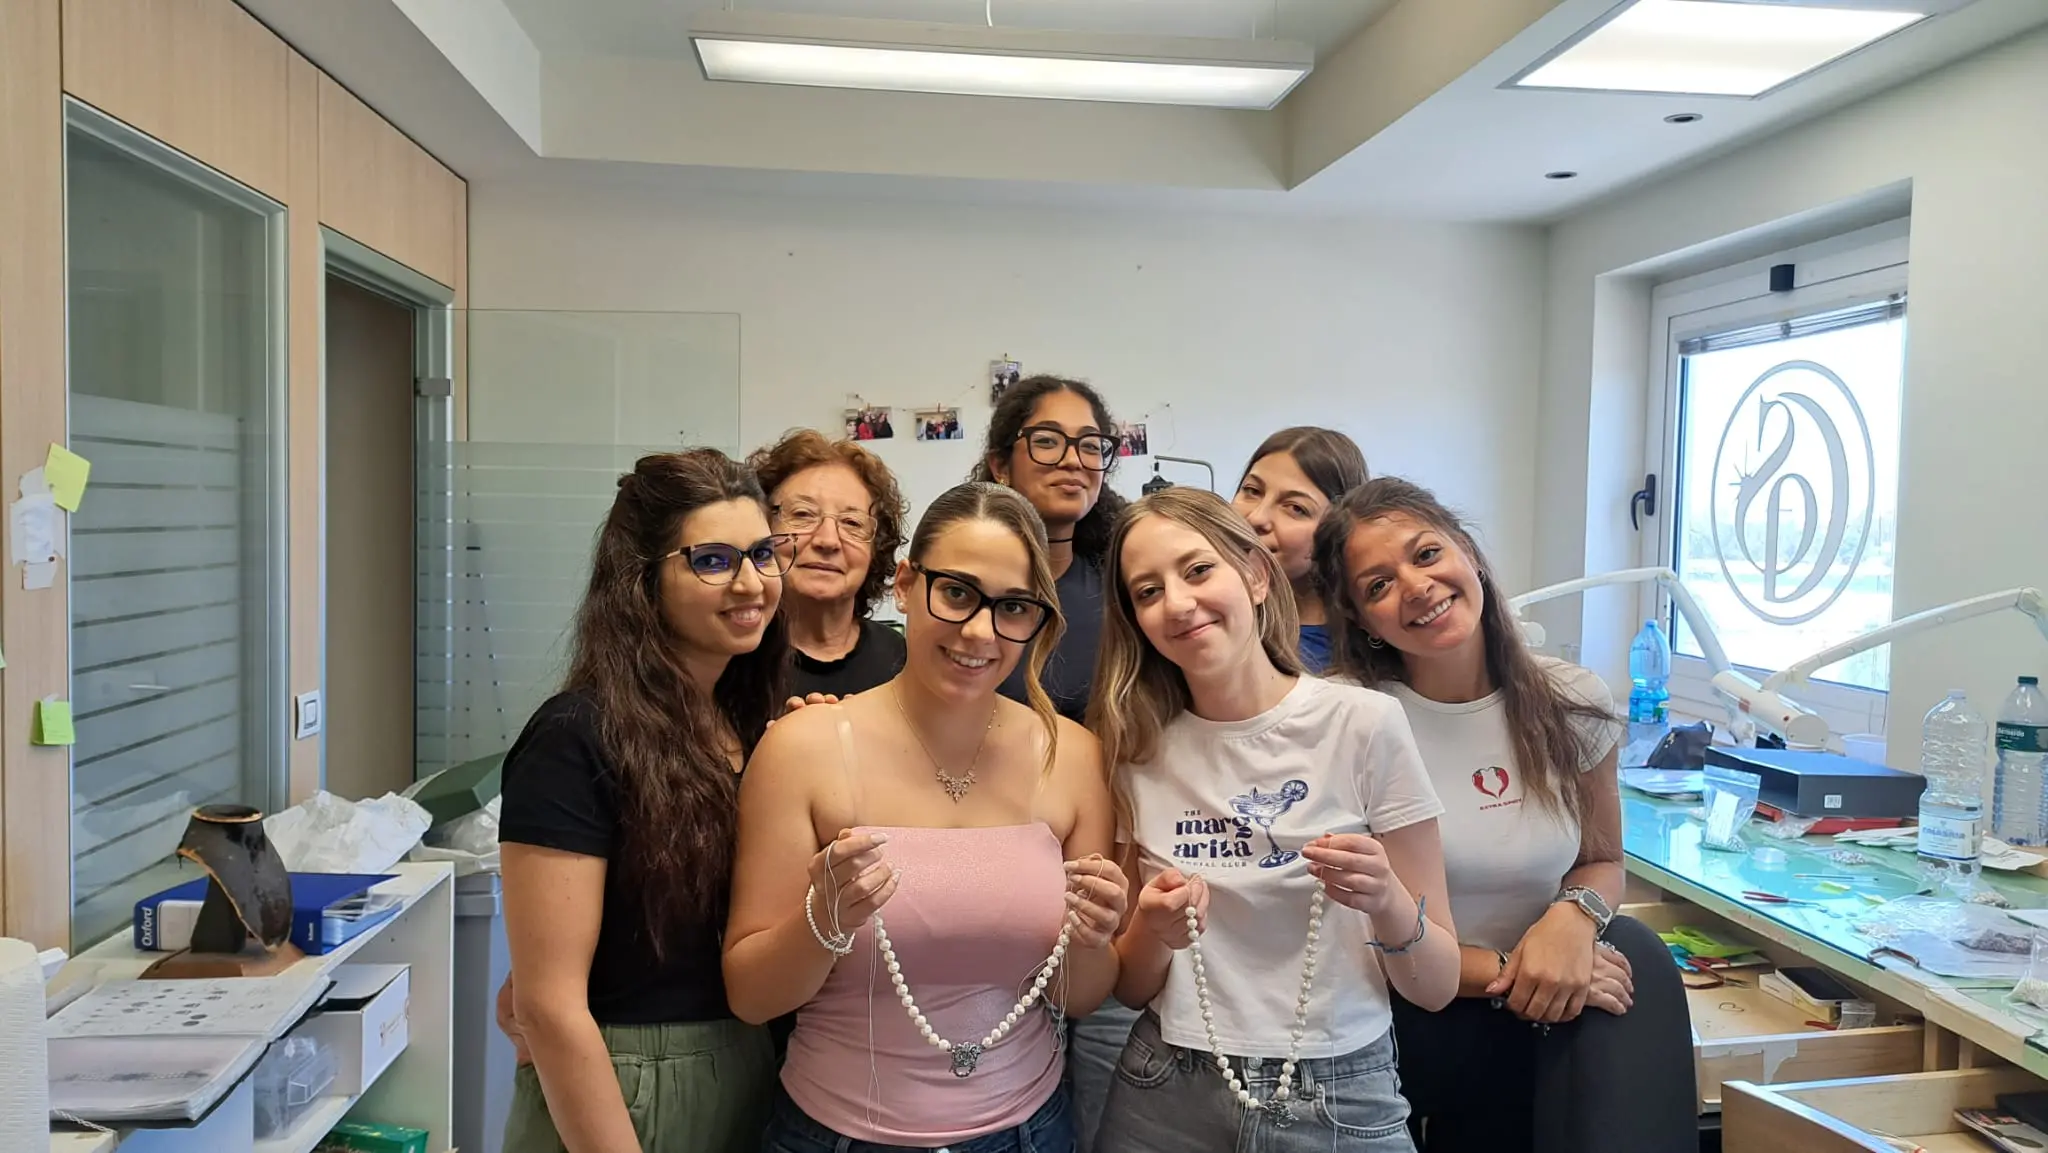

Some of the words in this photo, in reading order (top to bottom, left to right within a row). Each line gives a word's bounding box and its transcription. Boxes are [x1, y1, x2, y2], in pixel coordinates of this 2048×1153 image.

[1184, 809, 1201, 817] THE
[1175, 816, 1254, 839] marg
[1172, 838, 1254, 858] arita
[141, 906, 153, 947] Oxford
